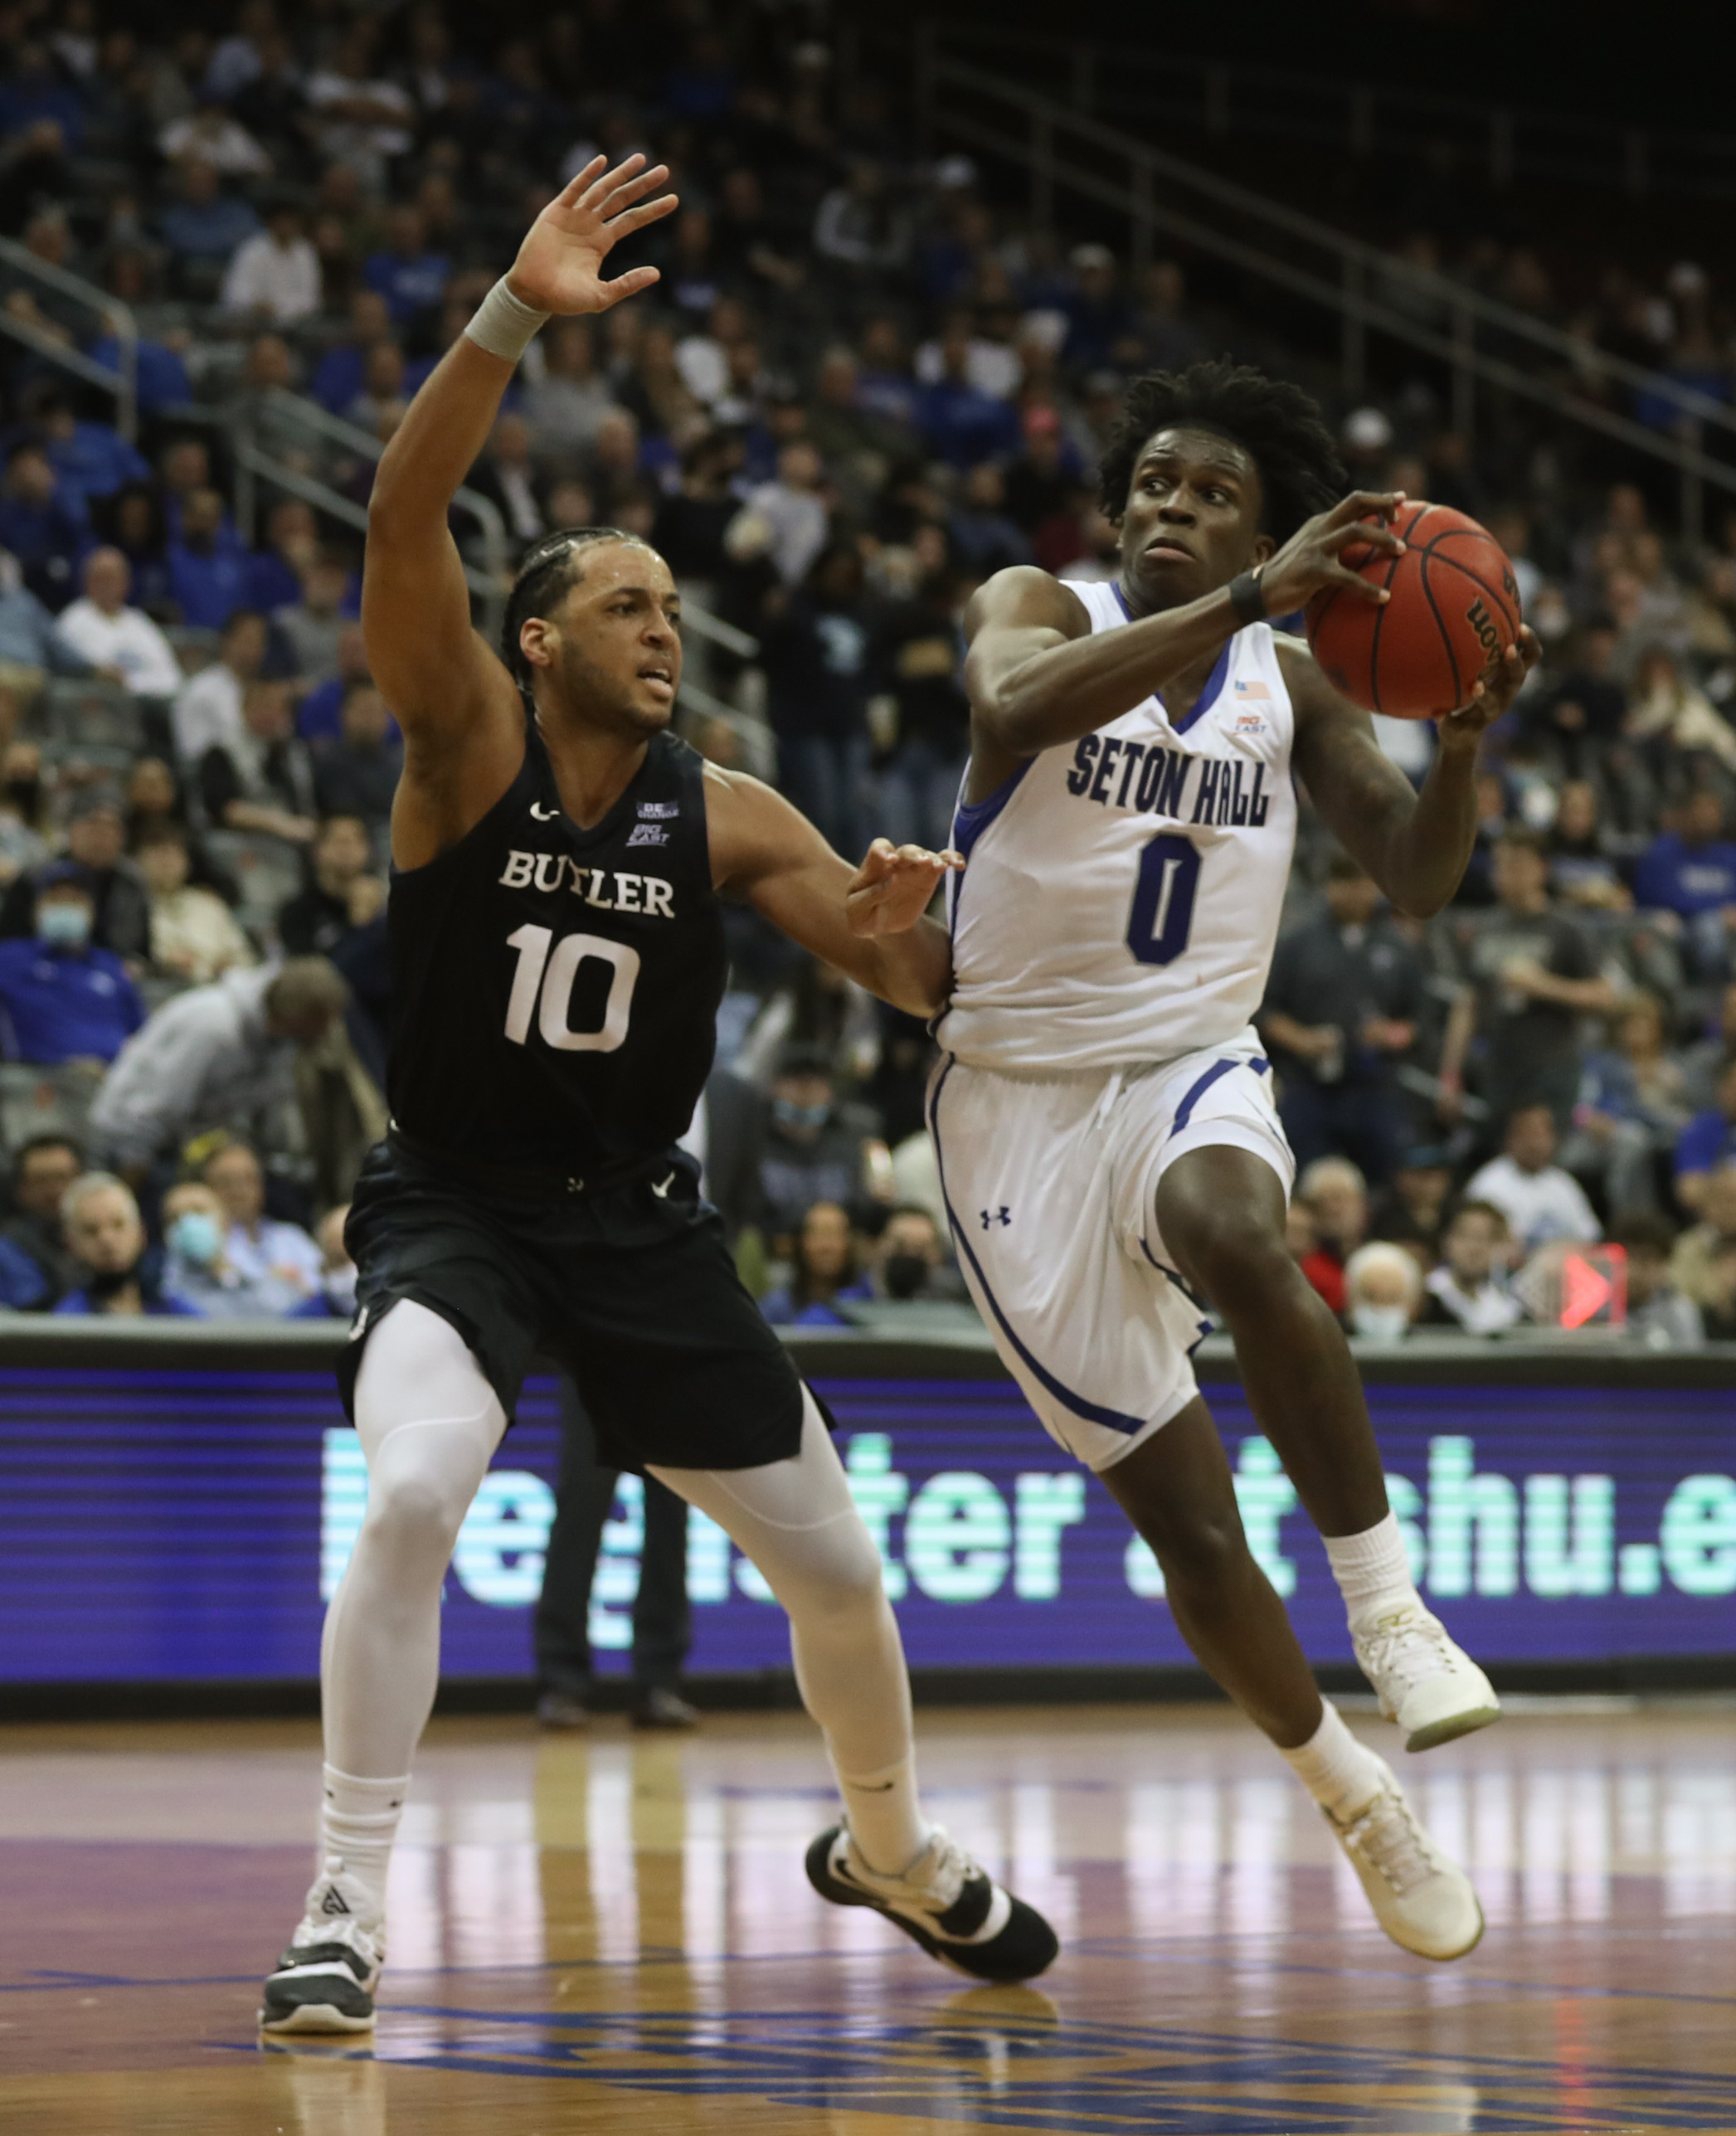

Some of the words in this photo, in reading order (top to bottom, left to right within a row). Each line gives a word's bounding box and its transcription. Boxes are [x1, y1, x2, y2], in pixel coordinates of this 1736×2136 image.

[1235, 725, 1267, 733] EAST
[1067, 734, 1195, 818] SETON
[1190, 758, 1270, 827] HALL
[629, 833, 670, 844] EAST
[498, 849, 675, 918] BUTLER
[1125, 832, 1203, 966] 0
[504, 922, 640, 1053] 10
